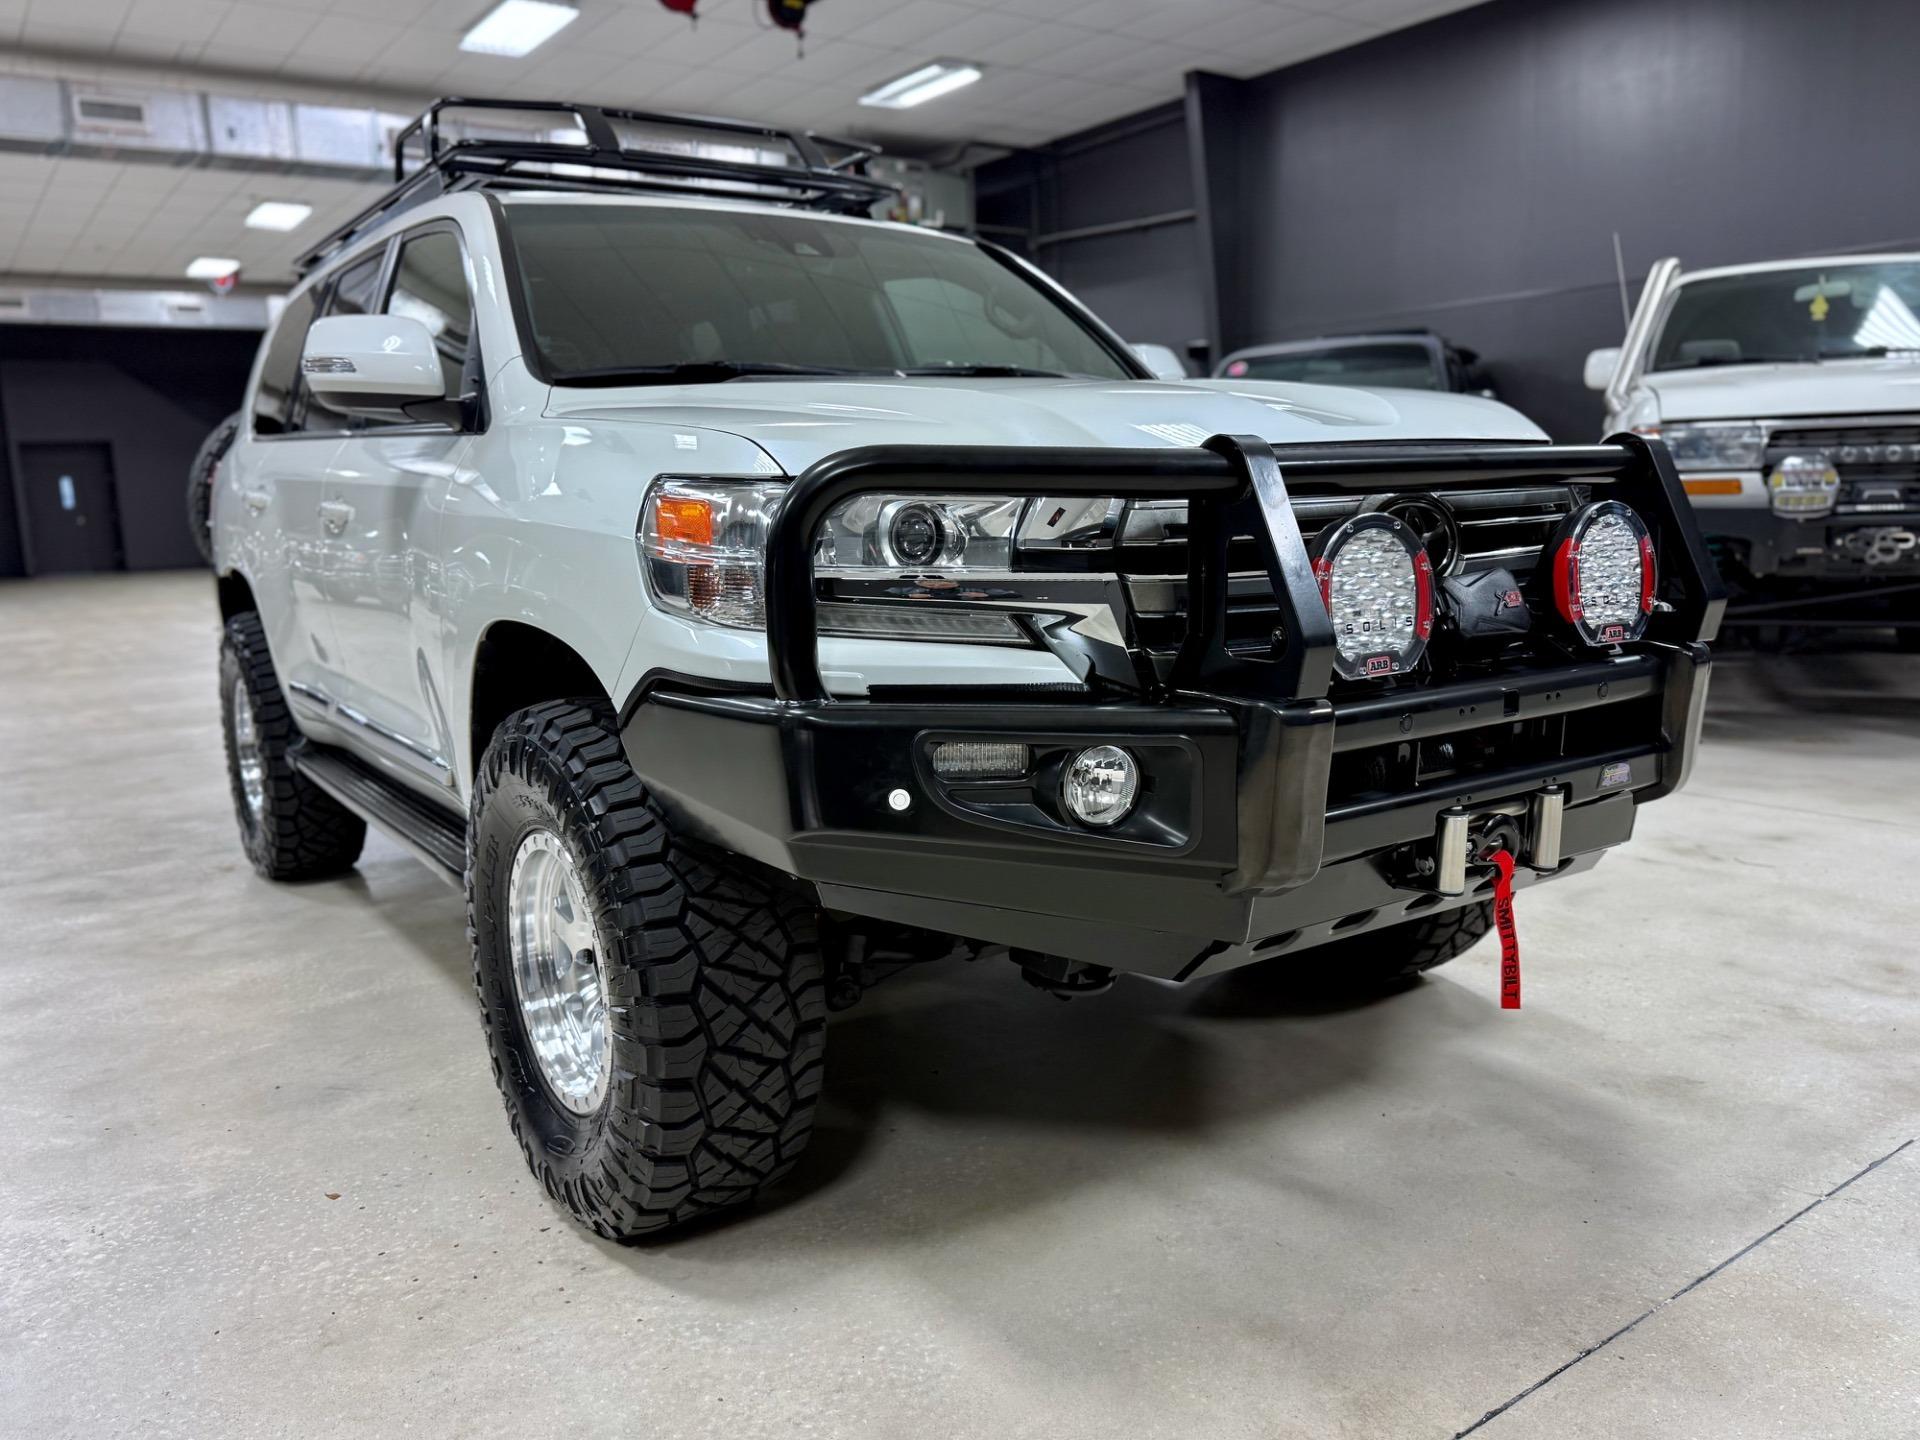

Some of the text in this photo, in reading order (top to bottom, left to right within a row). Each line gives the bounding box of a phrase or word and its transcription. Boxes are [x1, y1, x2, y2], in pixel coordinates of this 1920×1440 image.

[1346, 616, 1413, 634] SOLIS
[1369, 659, 1389, 672] ARB
[1499, 898, 1518, 999] SMITTYBILT
